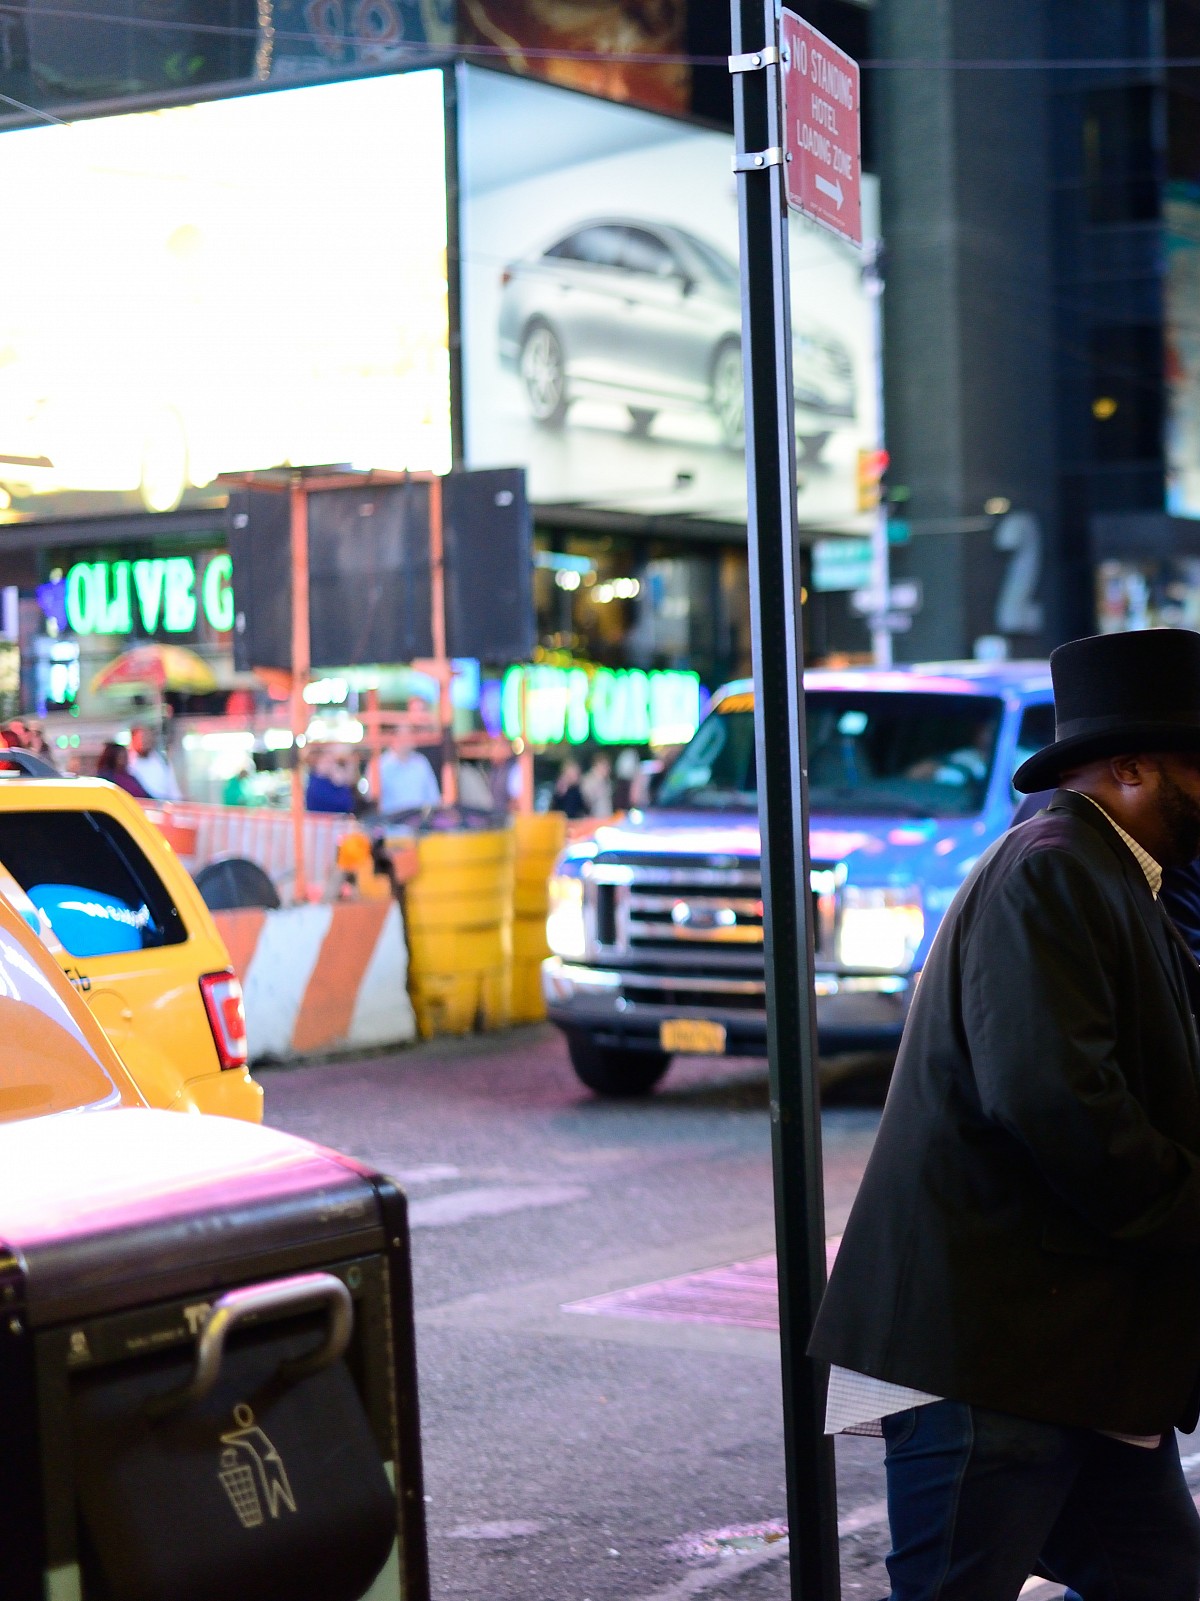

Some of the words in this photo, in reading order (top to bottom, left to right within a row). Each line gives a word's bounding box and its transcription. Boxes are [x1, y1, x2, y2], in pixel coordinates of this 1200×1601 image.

[792, 34, 808, 75] NO
[810, 49, 853, 111] STANDING
[811, 93, 839, 136] HOTEL
[796, 119, 831, 166] LOADING
[832, 143, 853, 181] ZONE
[65, 556, 198, 635] OLIVE
